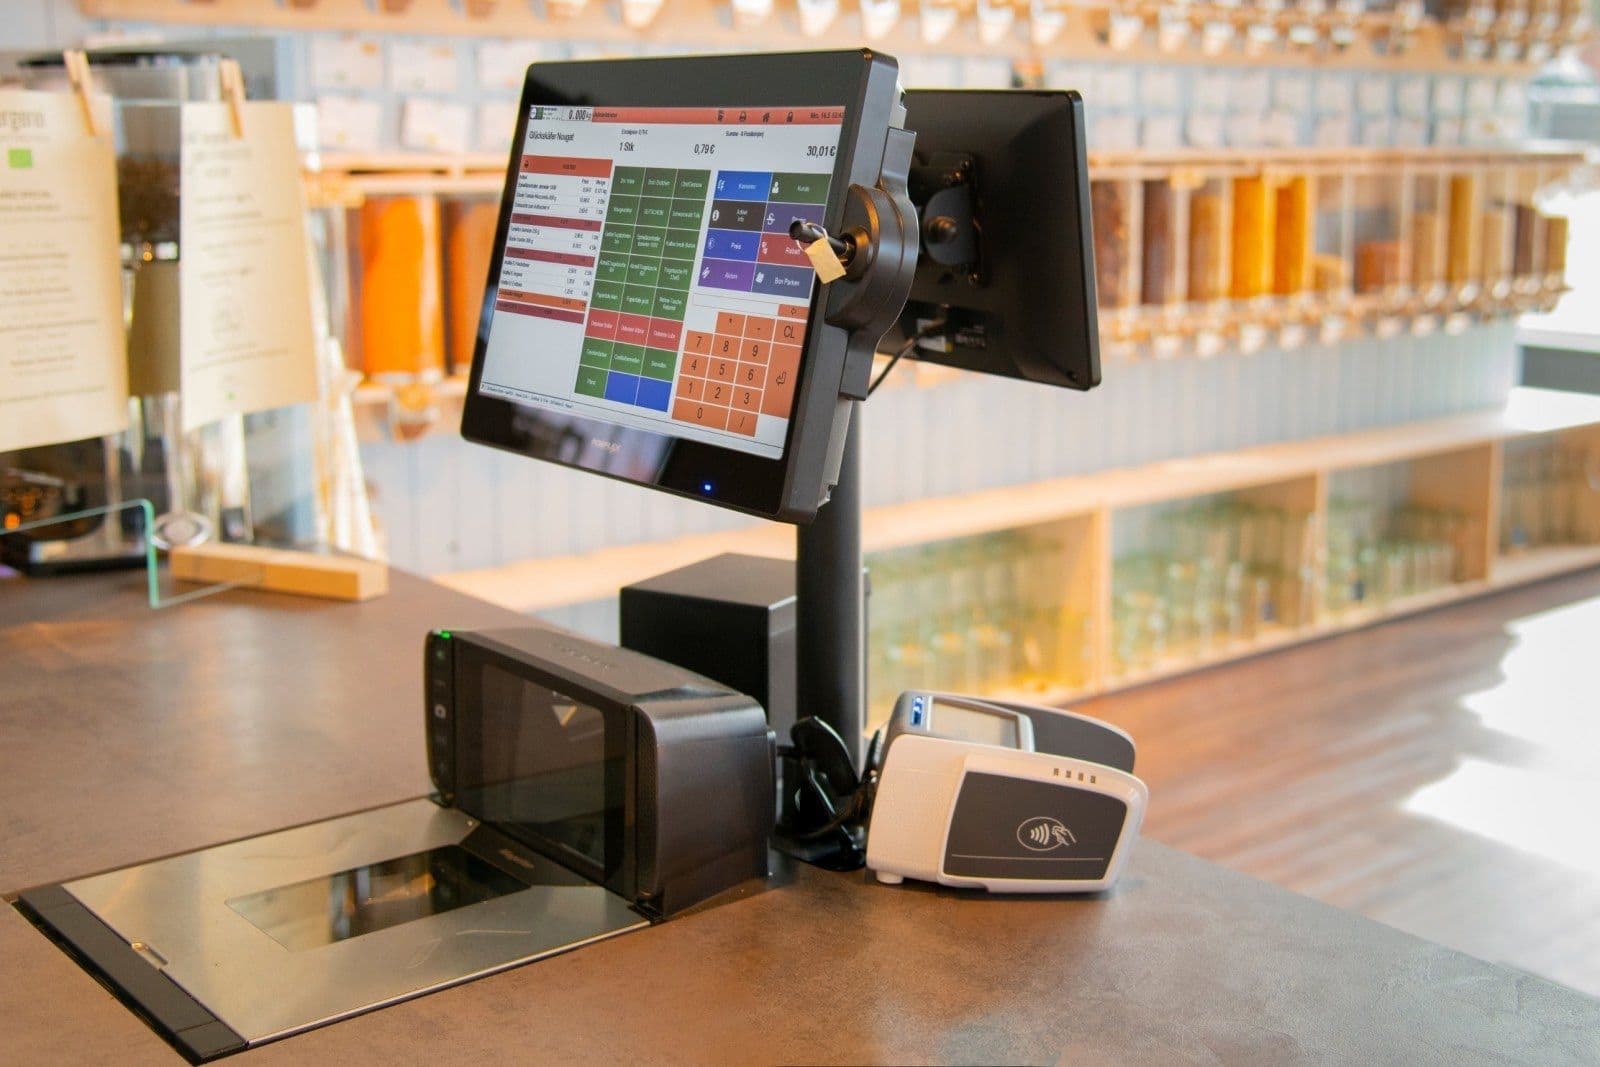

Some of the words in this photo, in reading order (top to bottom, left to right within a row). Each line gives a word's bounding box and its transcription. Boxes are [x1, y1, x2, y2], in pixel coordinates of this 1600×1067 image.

[556, 132, 575, 143] Nougat
[623, 142, 635, 151] Stk
[783, 325, 795, 339] CL
[696, 335, 703, 348] 7
[723, 340, 730, 352] 8
[752, 344, 759, 357] 9
[691, 359, 698, 371] 4
[719, 363, 726, 376] 5
[747, 368, 755, 381] 6
[688, 382, 694, 394] 1
[714, 386, 721, 399] 2
[743, 392, 751, 405] 3
[697, 407, 704, 420] 0
